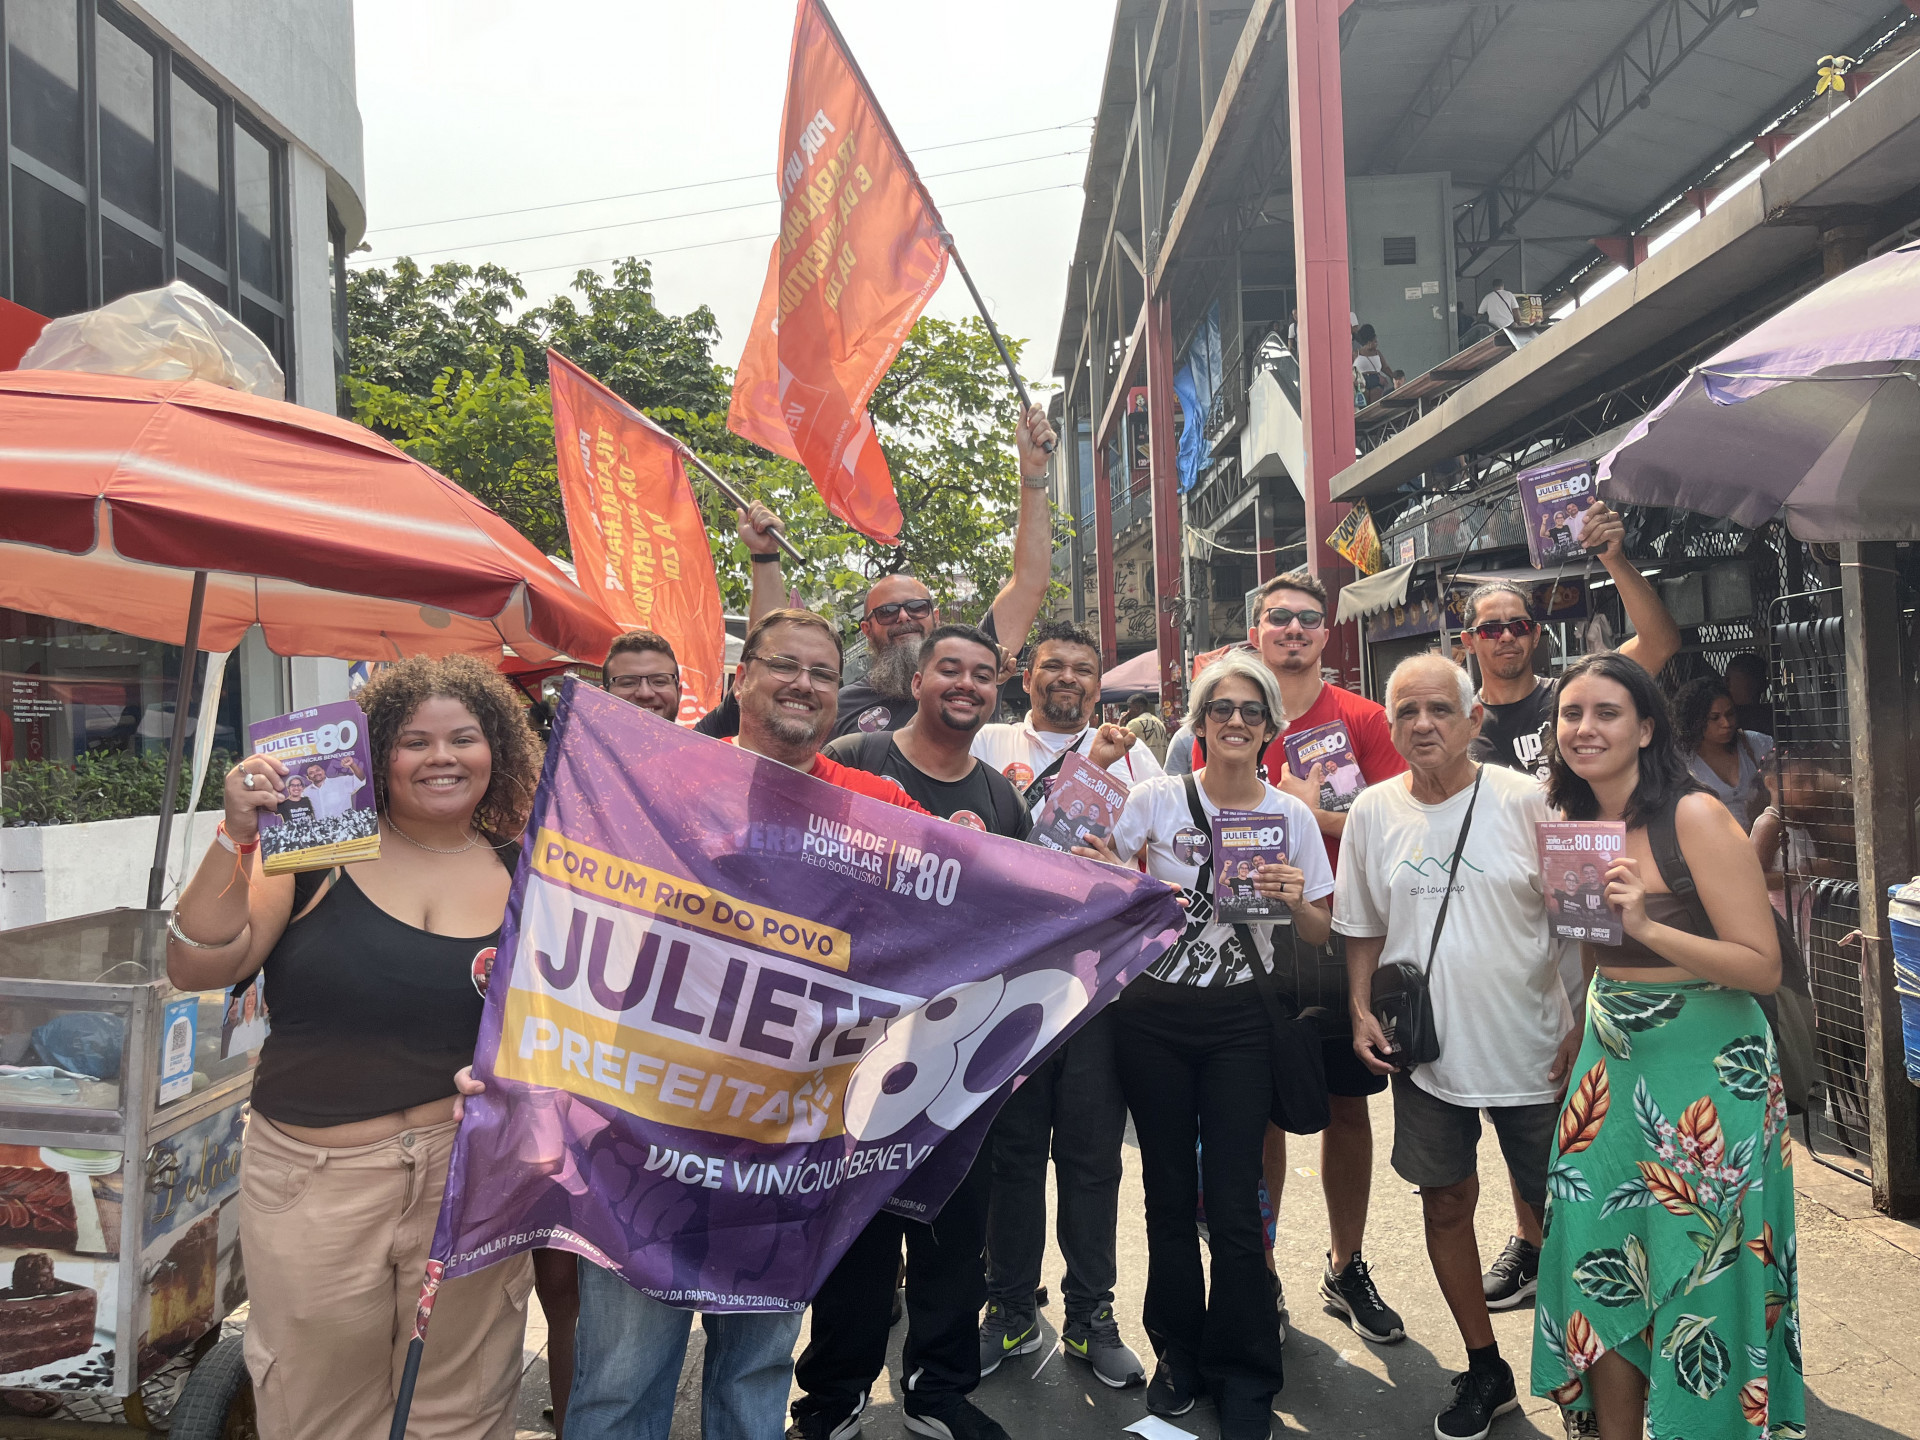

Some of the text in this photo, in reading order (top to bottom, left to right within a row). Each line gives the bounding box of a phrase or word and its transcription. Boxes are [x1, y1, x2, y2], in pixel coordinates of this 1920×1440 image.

[1538, 473, 1590, 496] JULIETE 80
[262, 732, 315, 754] JULIETE
[316, 720, 358, 755] 80
[1323, 732, 1346, 752] 80
[1513, 733, 1542, 762] UP
[323, 750, 356, 761] BENEVIDES
[1094, 780, 1124, 809] 80.800
[808, 813, 888, 855] UNIDADE
[1223, 826, 1284, 847] JULIETE 80
[1575, 834, 1621, 851] 80.800
[800, 852, 882, 887] PELO SOCIALISMO
[802, 832, 883, 874] POPULAR
[896, 844, 961, 906] UP 80
[545, 843, 833, 956] POR UM RIO DO POVO
[1586, 894, 1600, 910] UP
[535, 908, 901, 1062] JULIETE
[518, 1015, 795, 1125] PREFEITA
[843, 968, 1088, 1142] 80
[643, 1144, 725, 1190] VICE
[733, 1156, 850, 1196] VINÍCIUS
[459, 1236, 507, 1264] POPULAR
[508, 1230, 535, 1246] PELO
[535, 1228, 600, 1257] SOCIALISMO
[641, 1288, 669, 1300] CNPJ
[669, 1290, 682, 1301] DA
